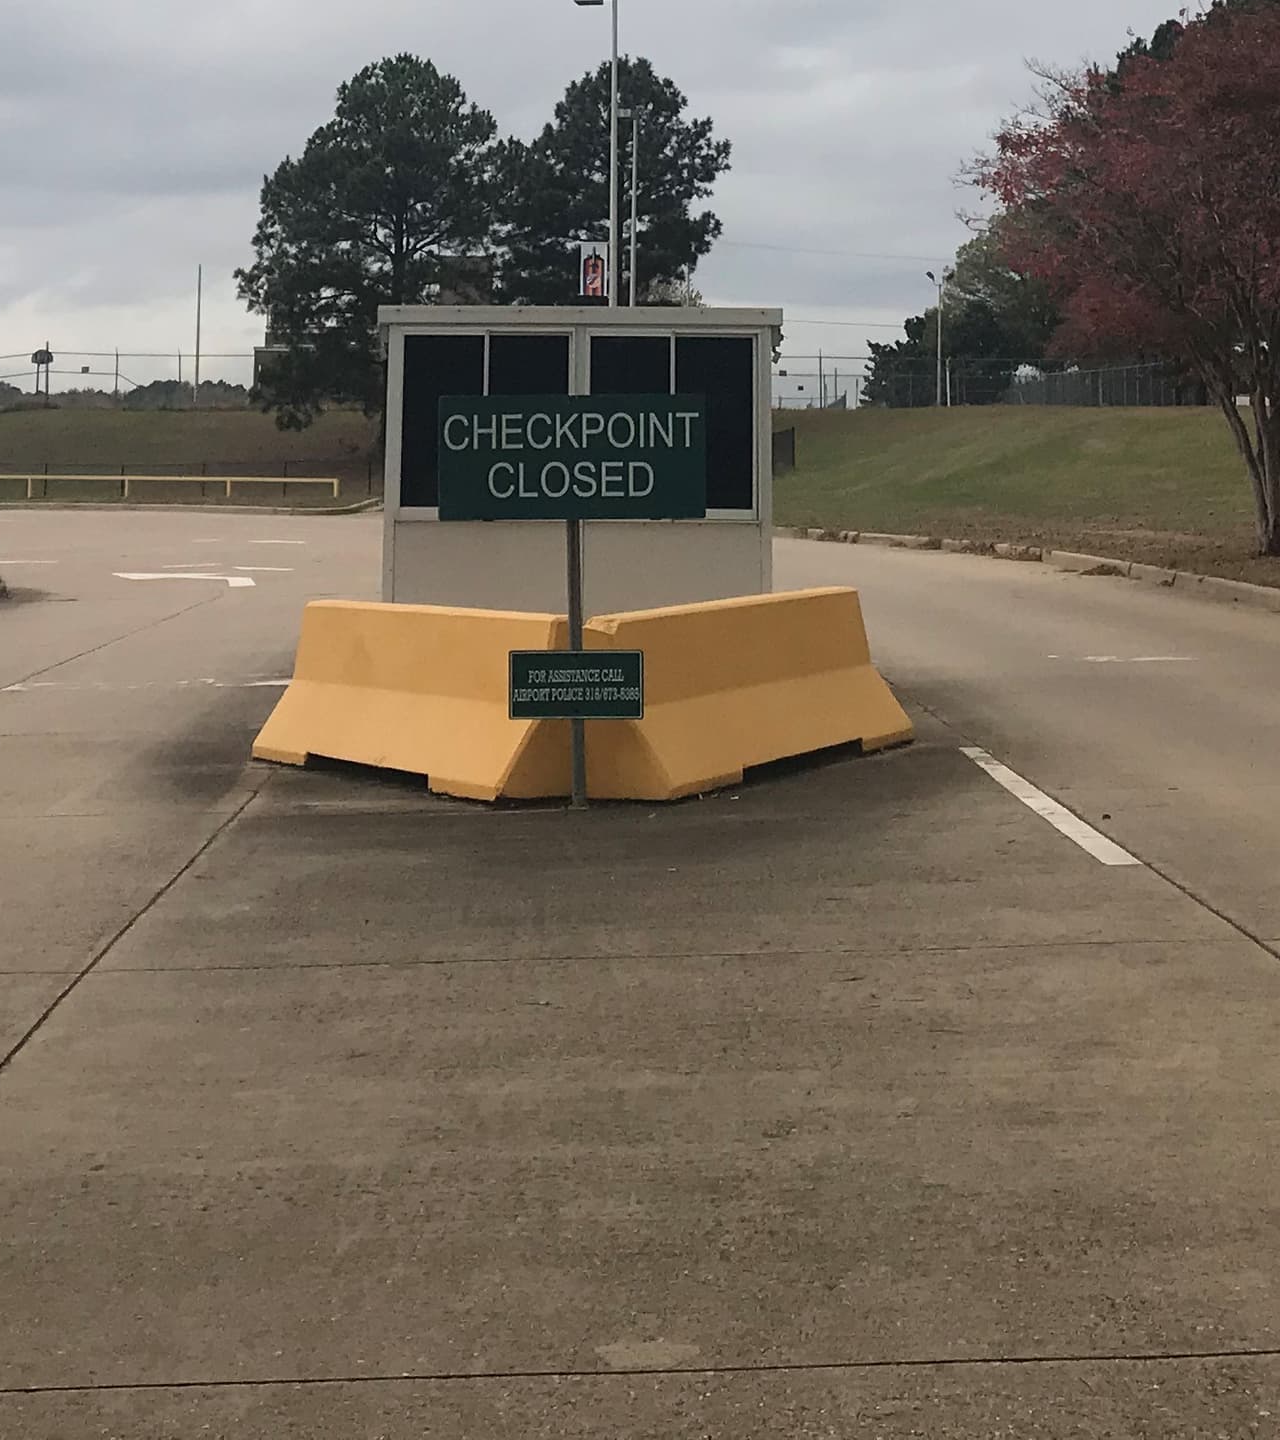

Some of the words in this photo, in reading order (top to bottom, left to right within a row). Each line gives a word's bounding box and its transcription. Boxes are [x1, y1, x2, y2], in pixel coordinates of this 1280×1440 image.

[443, 411, 700, 451] CHECKPOINT
[487, 460, 655, 499] CLOSED
[528, 670, 547, 683] FOR
[548, 669, 600, 683] ASSISTANCE
[601, 669, 624, 682] CALL
[513, 688, 550, 702] AIRPORT
[551, 688, 584, 701] POLICE
